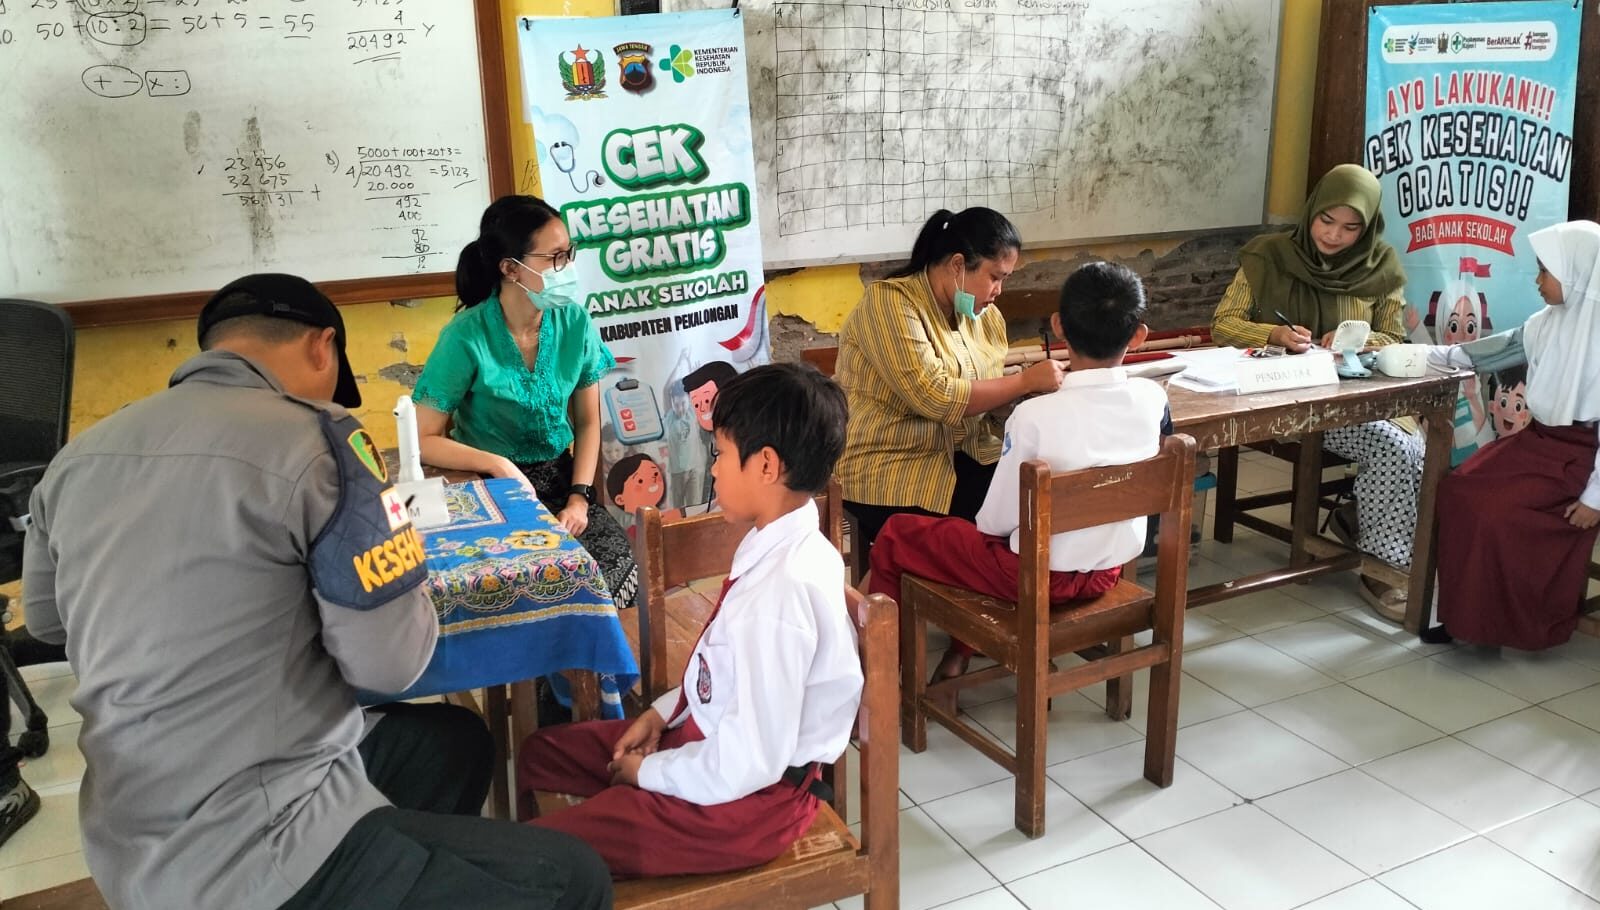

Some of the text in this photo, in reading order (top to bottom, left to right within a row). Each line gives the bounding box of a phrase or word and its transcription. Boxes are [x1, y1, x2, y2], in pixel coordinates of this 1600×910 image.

[283, 13, 316, 33] 55
[693, 46, 739, 56] KEMENTERIAN
[694, 54, 732, 62] KESEHATAN
[695, 60, 727, 68] REPUBLIK
[696, 66, 732, 75] INDONESIA
[1387, 71, 1556, 122] AYO LAKUKAN!!!
[603, 126, 703, 184] CEK
[1367, 112, 1573, 182] CEK KESEHATAN
[1398, 161, 1534, 221] GRATIS!!
[565, 188, 744, 241] KESEHATAN
[1414, 223, 1508, 245] BAGI ANAK SEKOLAH
[604, 227, 719, 274] GRATIS
[586, 273, 747, 315] ANAK SEKOLAH
[599, 303, 739, 343] KABUPATEN PEKALONGAN
